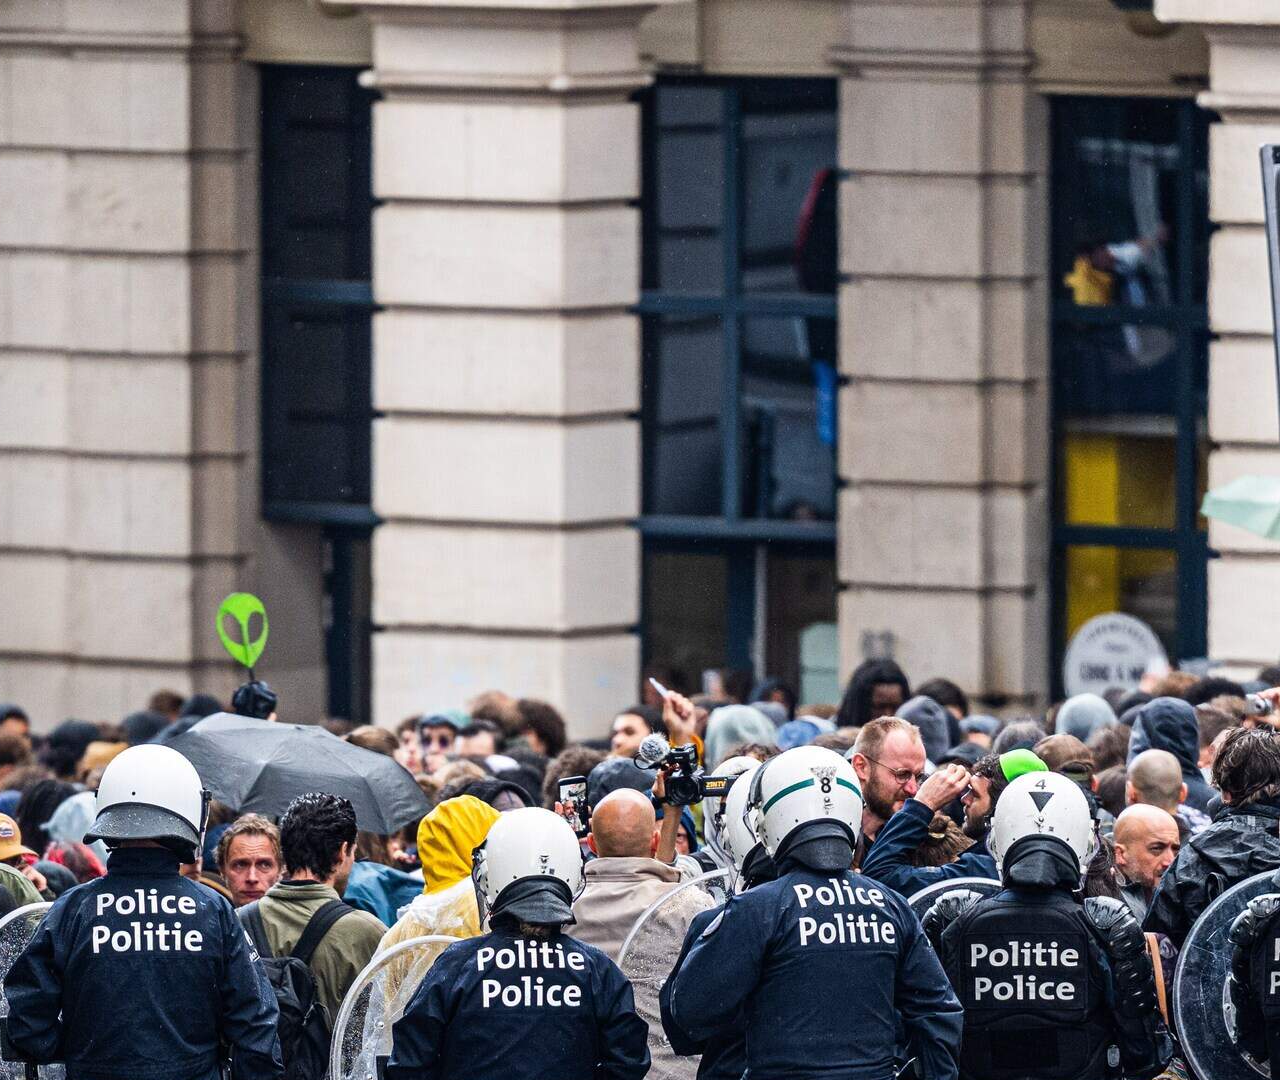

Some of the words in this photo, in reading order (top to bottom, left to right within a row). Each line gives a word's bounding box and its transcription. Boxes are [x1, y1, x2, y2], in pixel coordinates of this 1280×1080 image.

[821, 777, 832, 794] 8
[1035, 779, 1047, 790] 4
[96, 887, 196, 917] Police
[793, 877, 885, 908] Police
[92, 921, 203, 954] Politie
[798, 912, 896, 946] Politie
[477, 938, 585, 972] Politie
[970, 941, 1079, 967] Politie
[482, 975, 582, 1008] Police
[974, 974, 1075, 1001] Police
